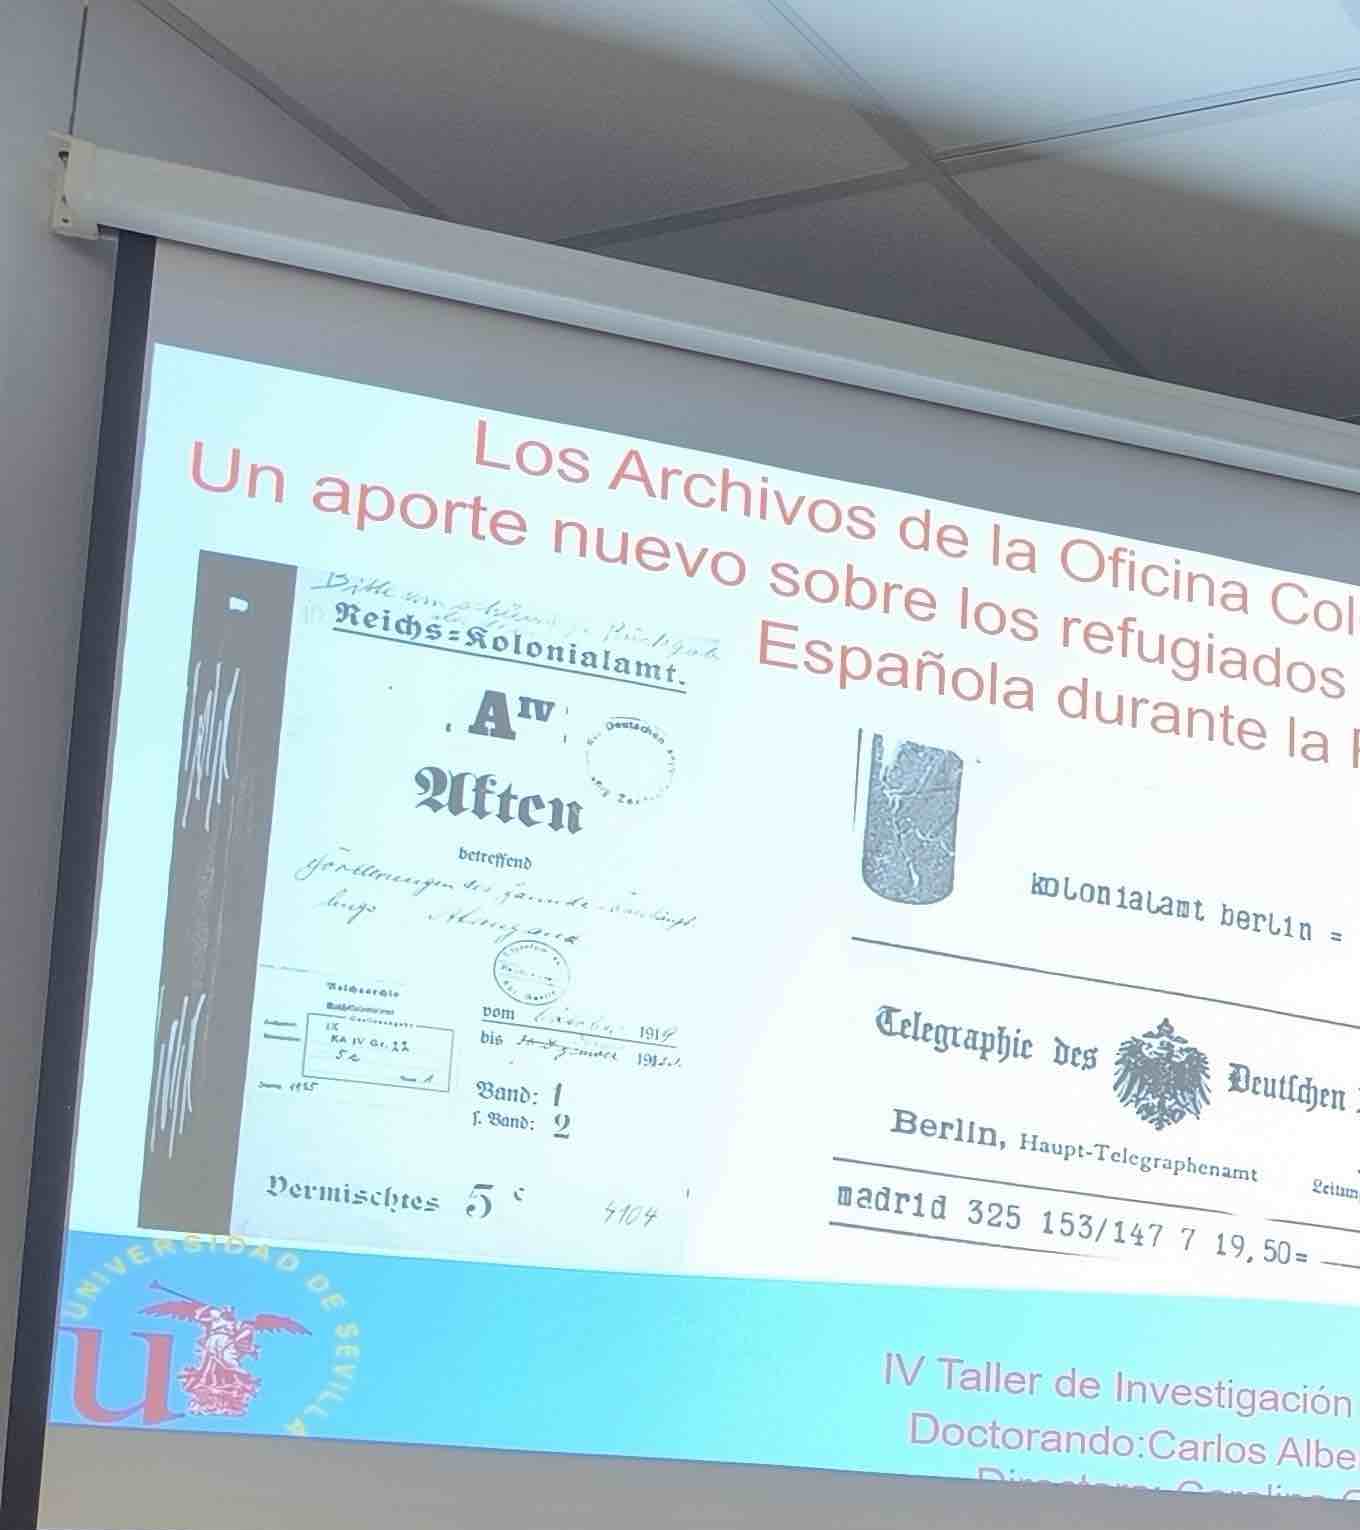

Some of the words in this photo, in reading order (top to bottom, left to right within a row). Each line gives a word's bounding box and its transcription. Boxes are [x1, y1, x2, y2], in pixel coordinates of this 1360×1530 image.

[475, 419, 589, 482] Los
[609, 447, 877, 541] Archivos
[898, 509, 969, 559] de
[992, 522, 1037, 573] la
[1059, 538, 1249, 616] Oficina
[191, 439, 285, 504] Un
[311, 475, 528, 545] aporte
[553, 519, 747, 587] nuevo
[771, 561, 937, 623] sobre
[960, 586, 1039, 641] los
[1061, 616, 1345, 700] refugiados
[759, 618, 1035, 713] Española
[1057, 676, 1266, 751] durante
[1288, 718, 1330, 765] la
[413, 765, 585, 836] Akten
[457, 845, 534, 872] betreffend
[1030, 871, 1206, 923] kolonialamt
[1219, 902, 1313, 943] berlin
[479, 1030, 504, 1046] bis
[482, 1005, 516, 1020] vom
[874, 1004, 1034, 1064] Telegraphie
[1052, 1035, 1100, 1072] des
[475, 1080, 539, 1106] Band:
[487, 1111, 536, 1131] Band:
[889, 1107, 1007, 1152] Berlin,
[1018, 1132, 1260, 1184] Haupt-Telegraphenamt
[265, 1174, 441, 1214] Vermischtes
[465, 1184, 496, 1219] 5
[837, 1184, 948, 1221] madrid
[967, 1199, 1022, 1231] 325
[1041, 1209, 1164, 1248] 153/147
[1180, 1226, 1197, 1252] 7
[884, 1351, 927, 1387] IV
[935, 1356, 1044, 1396] Taller
[1054, 1367, 1102, 1400] de
[1115, 1370, 1353, 1420] Investigación
